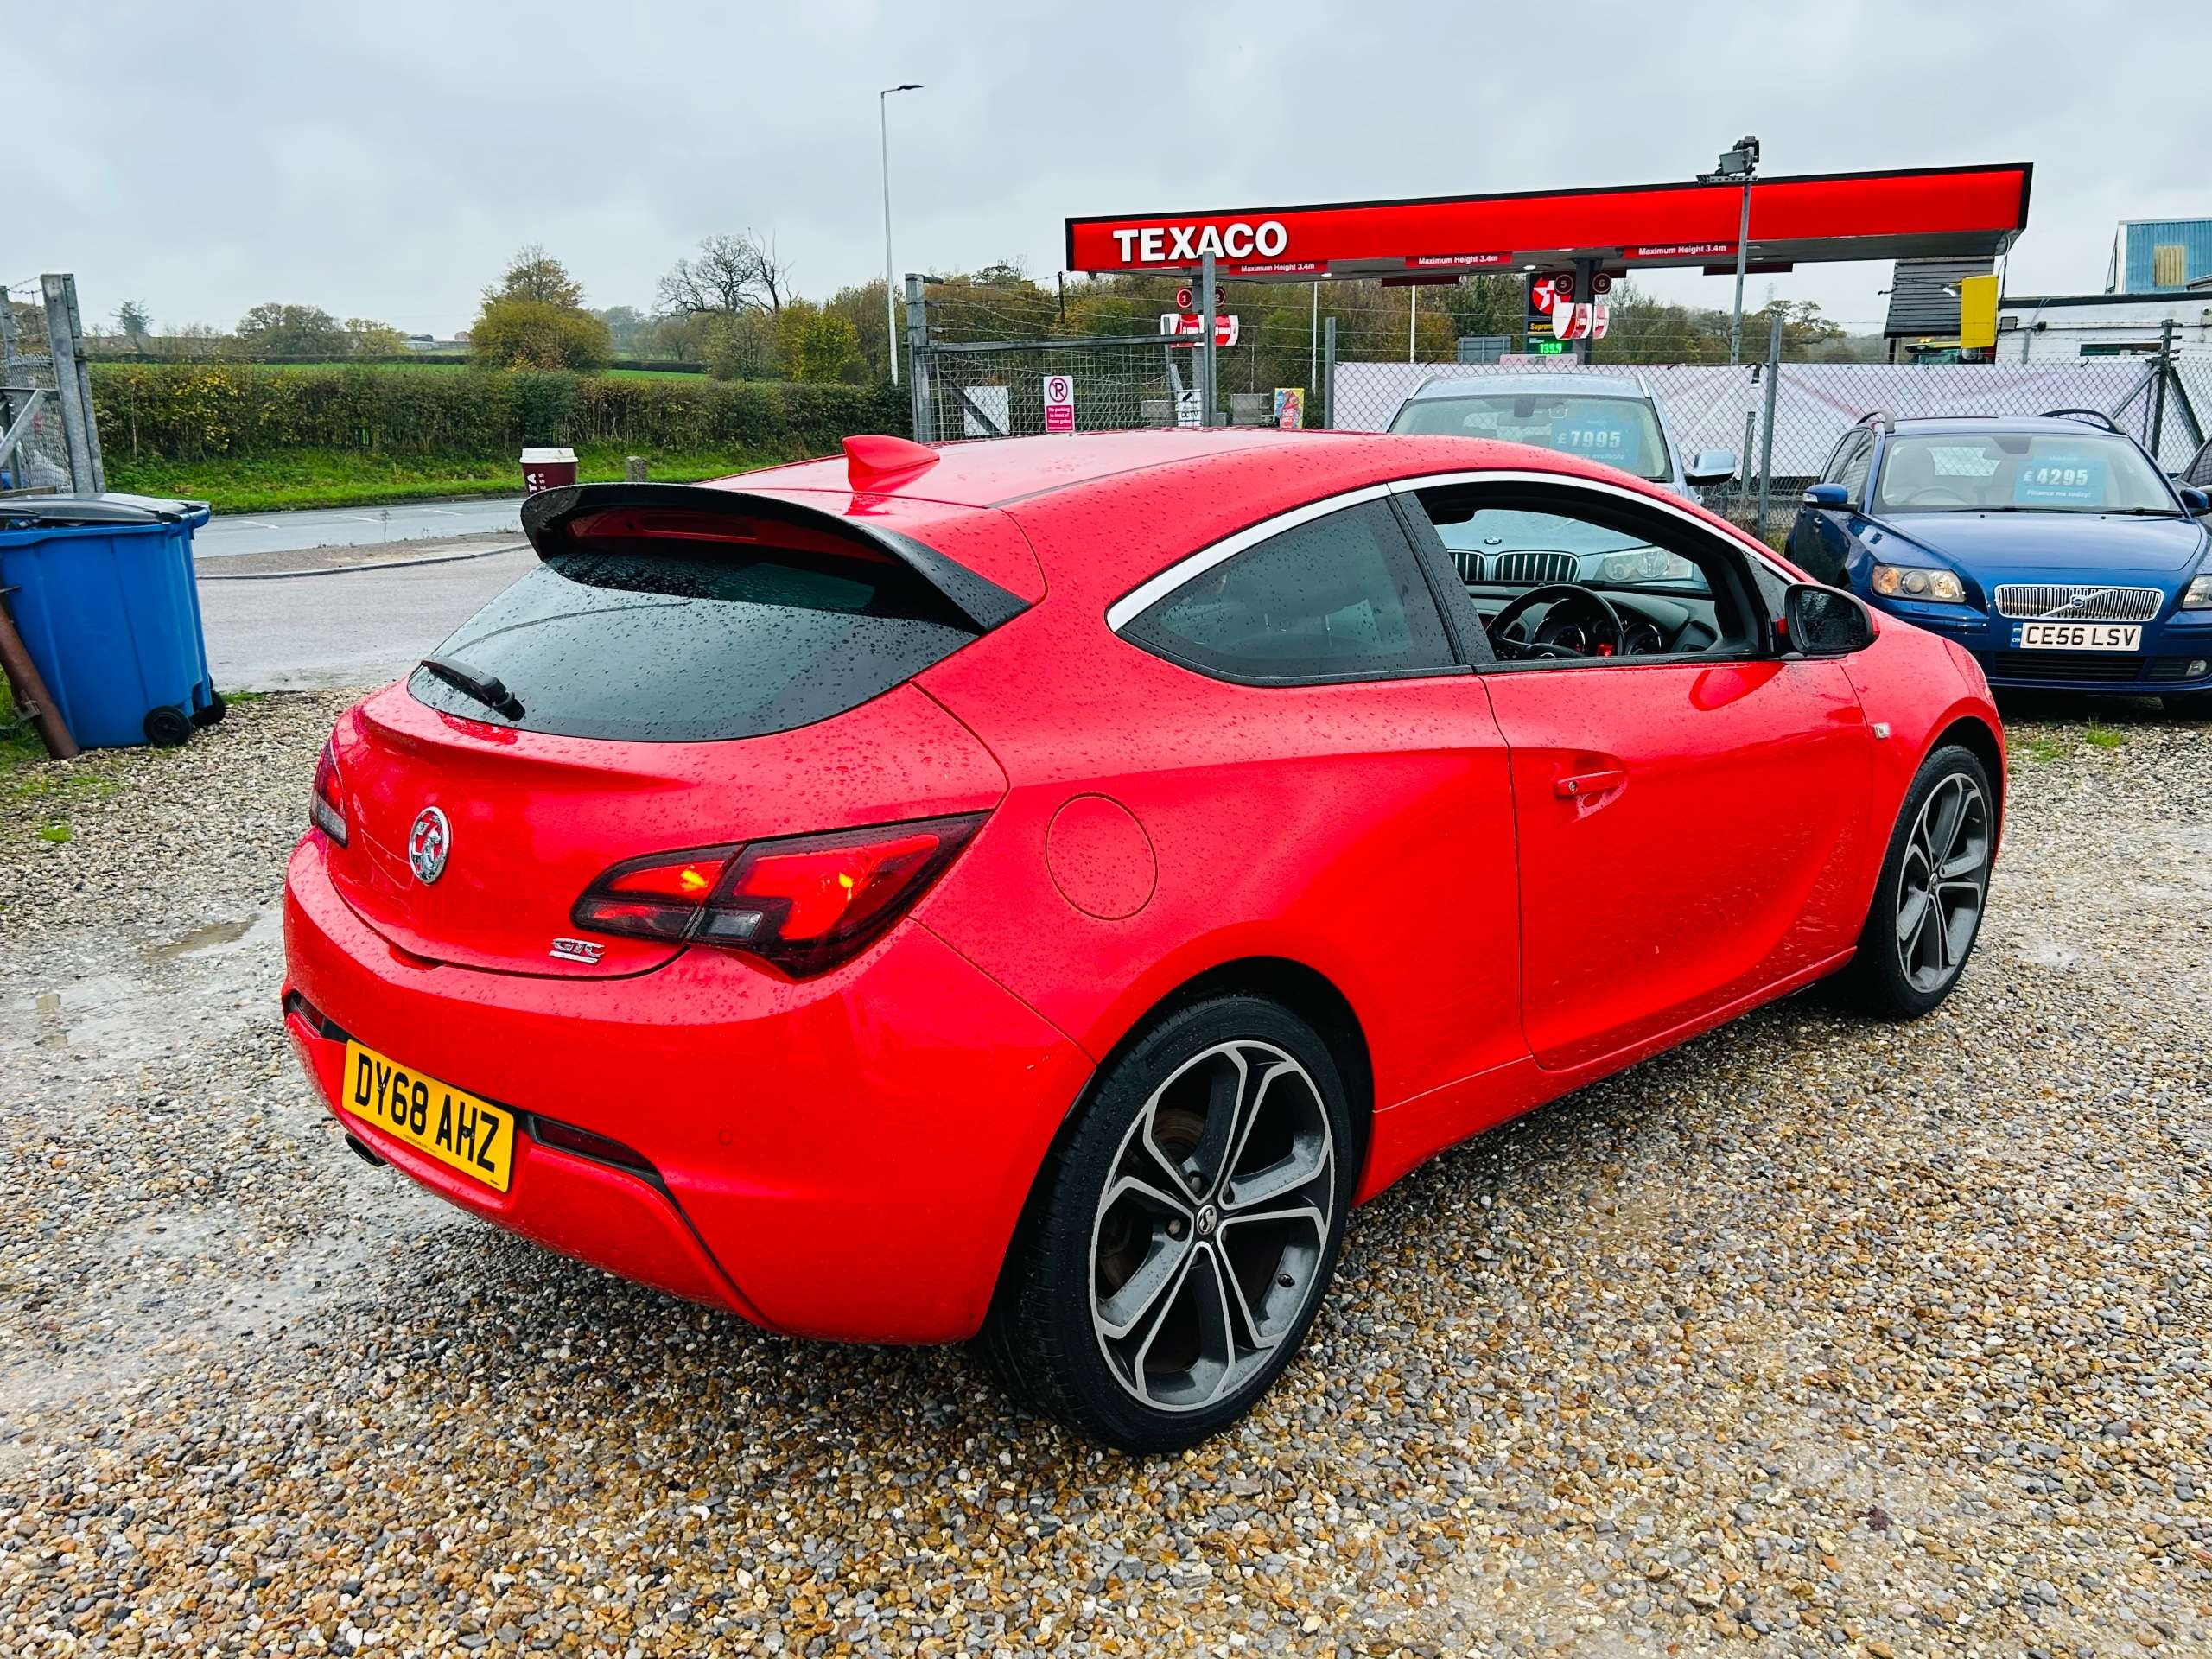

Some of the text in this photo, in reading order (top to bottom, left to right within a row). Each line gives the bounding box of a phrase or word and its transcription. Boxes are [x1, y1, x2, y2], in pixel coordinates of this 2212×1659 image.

[1113, 221, 1287, 262] TEXACO
[1638, 247, 1676, 256] Maximum
[1678, 245, 1704, 255] Height
[1418, 257, 1452, 265] Maximum
[1453, 256, 1478, 264] Height
[1274, 264, 1296, 272] Height
[1560, 280, 1567, 289] 5
[1599, 279, 1606, 288] 6
[1530, 322, 1553, 332] Suprem
[2026, 626, 2137, 647] CE56 LSV
[551, 938, 606, 957] GTC
[354, 1052, 499, 1173] DY68 AHZ
